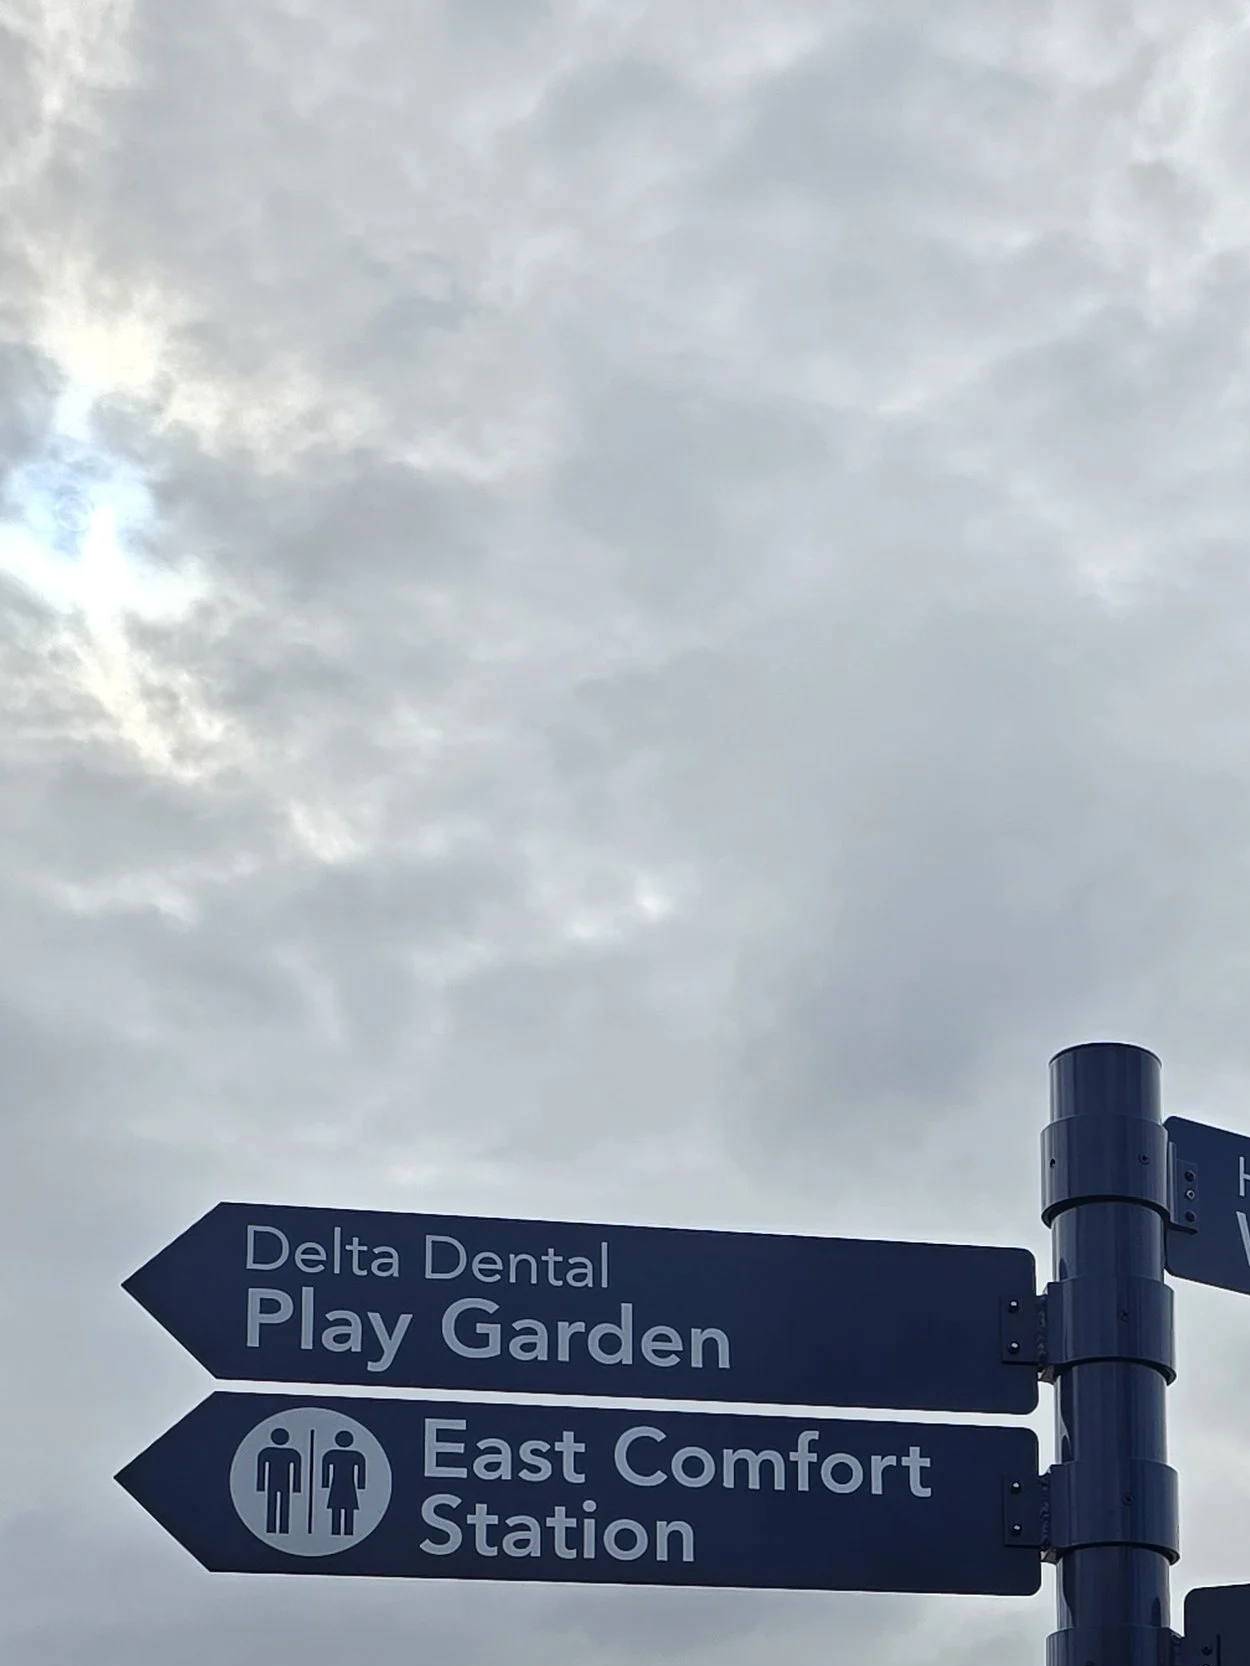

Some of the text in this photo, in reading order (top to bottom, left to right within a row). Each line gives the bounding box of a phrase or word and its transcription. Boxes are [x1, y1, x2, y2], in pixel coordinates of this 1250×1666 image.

[246, 1224, 609, 1289] Delta Dental
[246, 1287, 731, 1373] Play Garden
[424, 1418, 933, 1498] East Comfort
[419, 1493, 695, 1563] Station
